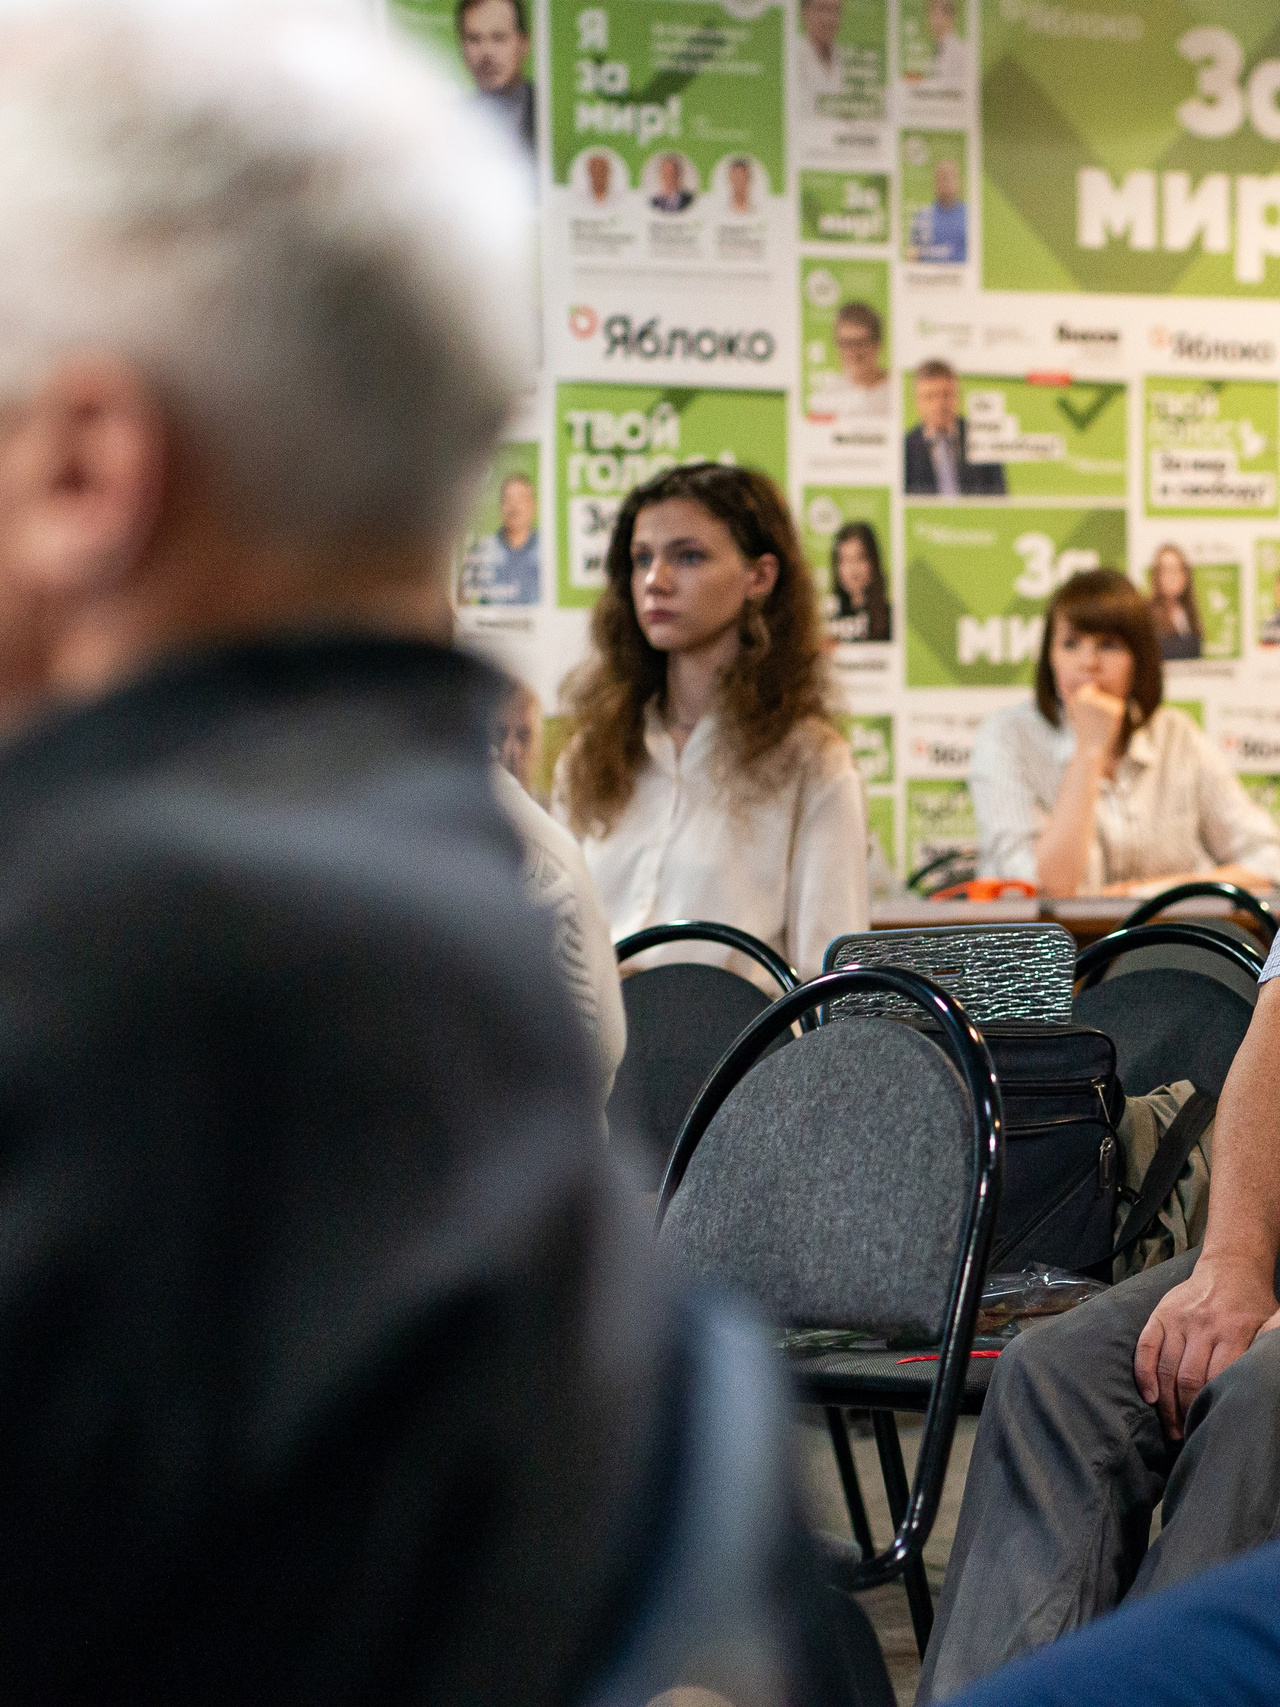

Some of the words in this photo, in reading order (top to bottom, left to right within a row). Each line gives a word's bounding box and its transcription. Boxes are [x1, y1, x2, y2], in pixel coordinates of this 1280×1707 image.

[577, 8, 607, 51] Я
[575, 97, 682, 147] мир!
[603, 313, 777, 363] Яблоко
